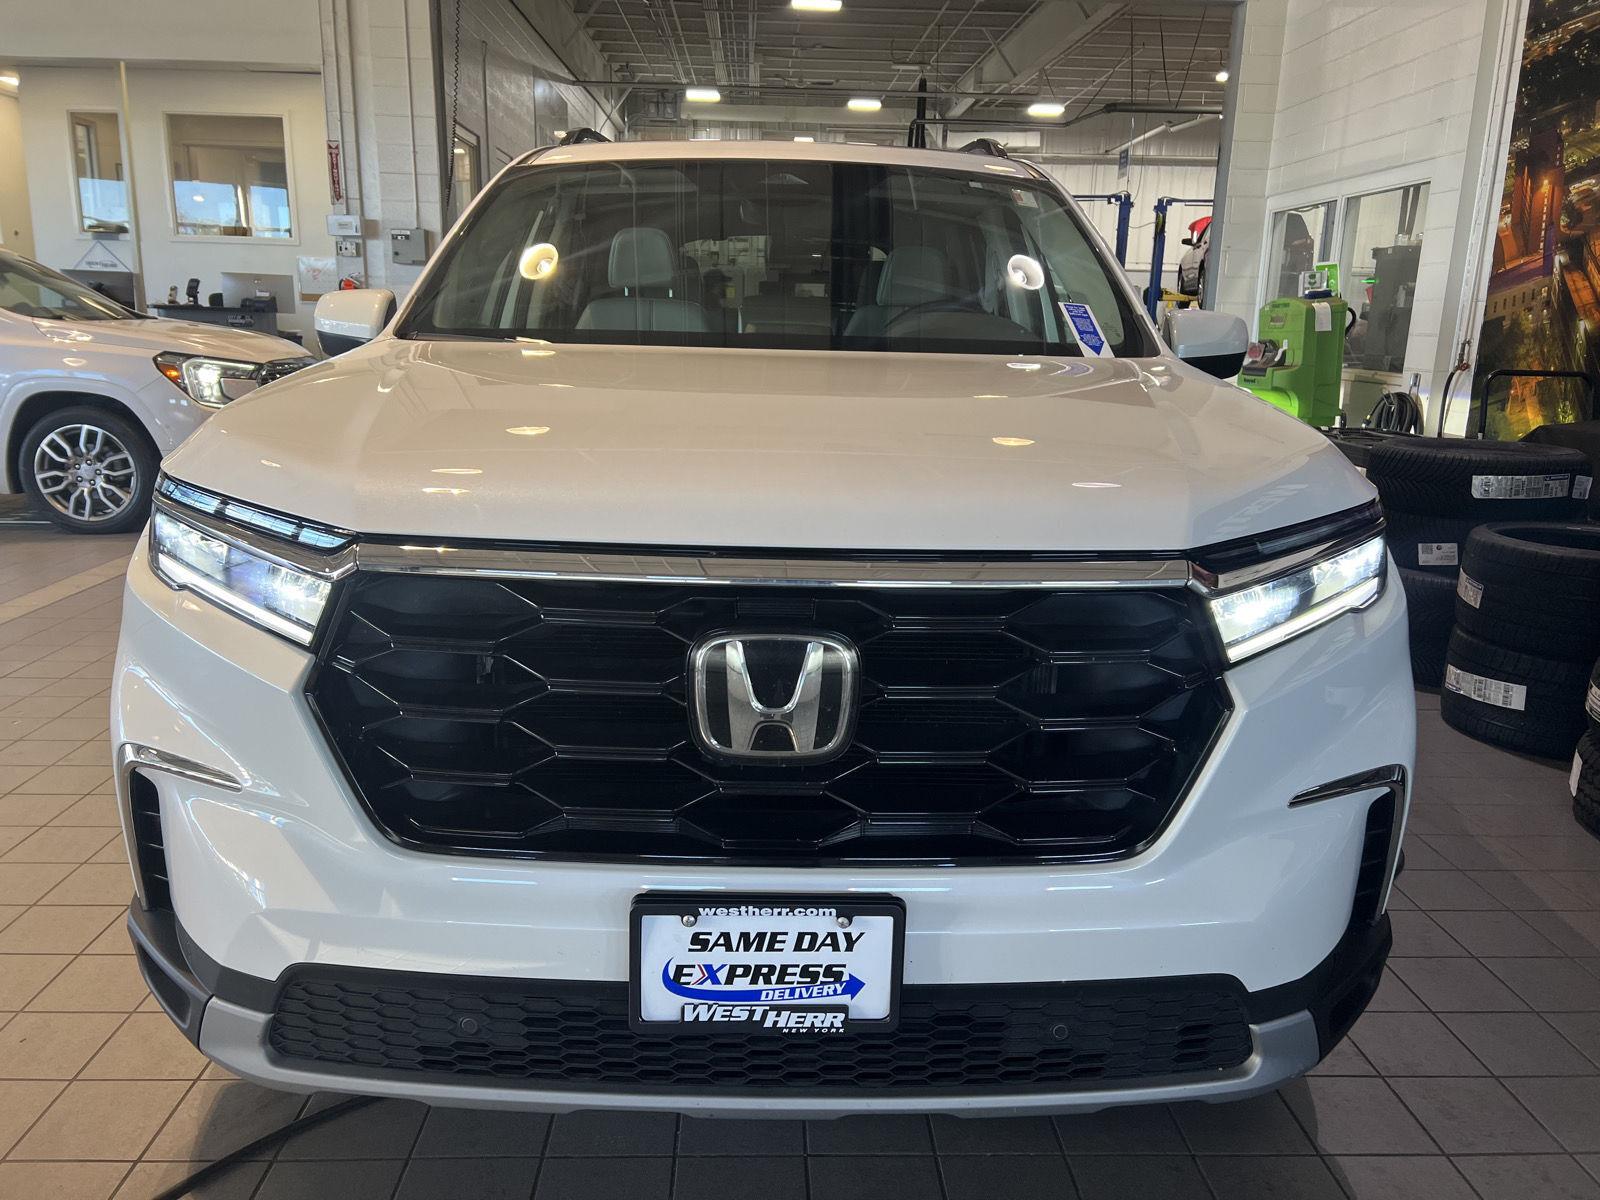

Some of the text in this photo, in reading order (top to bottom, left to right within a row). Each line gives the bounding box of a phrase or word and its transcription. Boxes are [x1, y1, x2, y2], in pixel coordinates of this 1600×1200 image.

[698, 905, 837, 917] westherr.com
[687, 931, 866, 953] SAME DAY
[672, 963, 847, 986] EXPRESS
[759, 982, 847, 1001] DELIVERY
